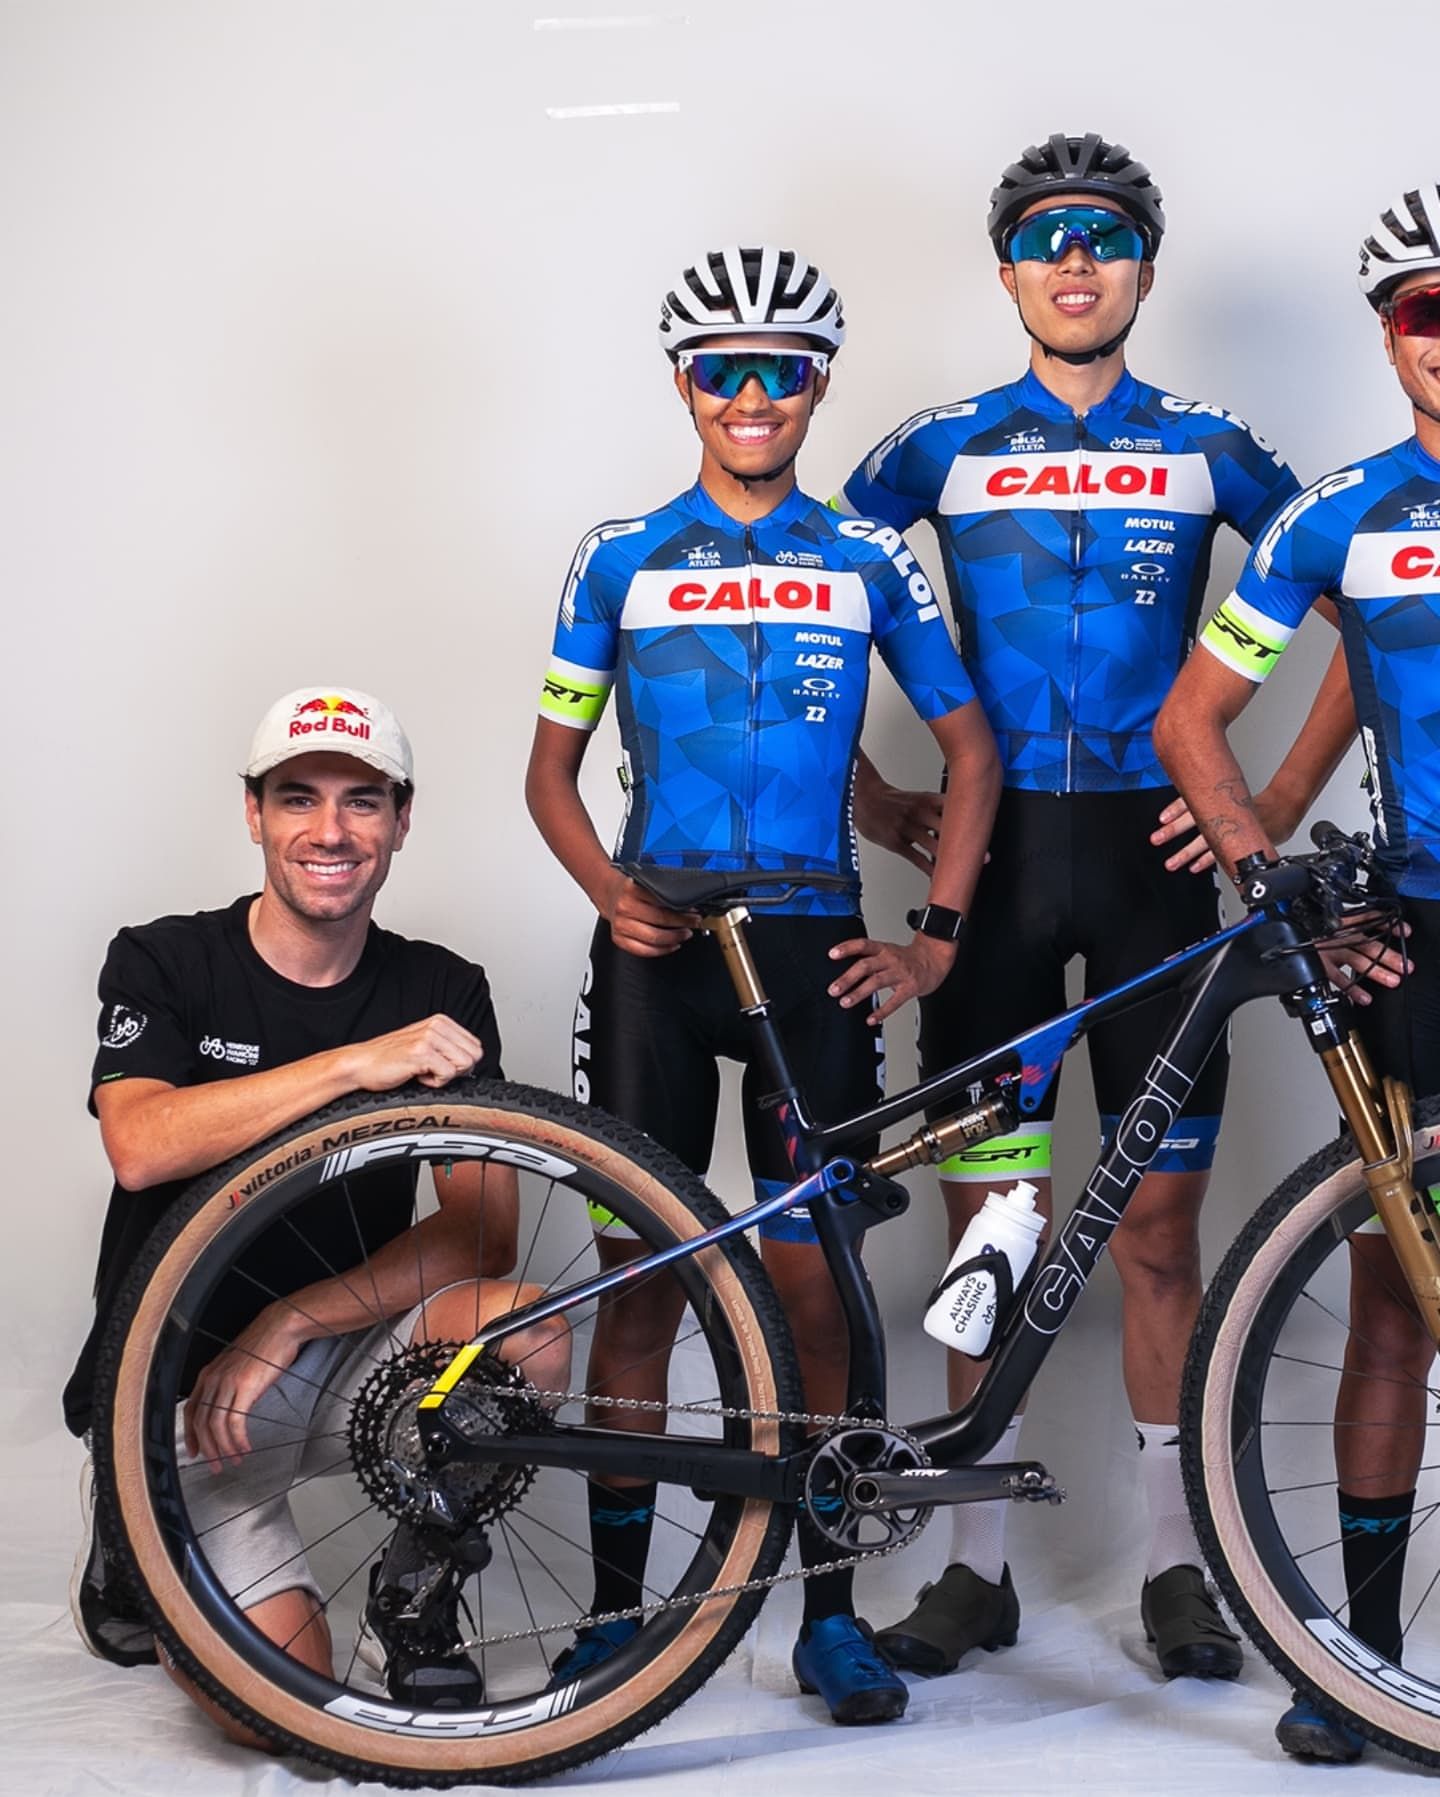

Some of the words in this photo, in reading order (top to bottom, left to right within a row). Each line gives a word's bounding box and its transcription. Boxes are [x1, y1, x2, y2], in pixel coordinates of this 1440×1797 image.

[1010, 435, 1046, 445] BOLSA
[1010, 444, 1046, 453] ATLETA
[985, 464, 1168, 497] CALOI
[1124, 517, 1176, 531] MOTUL
[1409, 510, 1440, 520] BOLS
[687, 551, 721, 560] BOLSA
[1124, 539, 1176, 555] LAZER
[688, 559, 721, 568] ATLETA
[838, 519, 941, 624] CALOI
[668, 577, 832, 612] CALOI
[794, 631, 843, 647] MOTUL
[794, 653, 845, 670] LAZER
[289, 716, 328, 739] Red
[332, 717, 370, 740] Bull
[574, 955, 594, 1104] CALO
[240, 1146, 314, 1195] vittoria
[321, 1116, 461, 1152] MEZCAL
[346, 1133, 578, 1179] FSA
[1024, 1054, 1194, 1334] CALOI
[949, 1275, 977, 1321] ALWAYS
[954, 1280, 988, 1334] CHASING
[1304, 1618, 1440, 1719] SA
